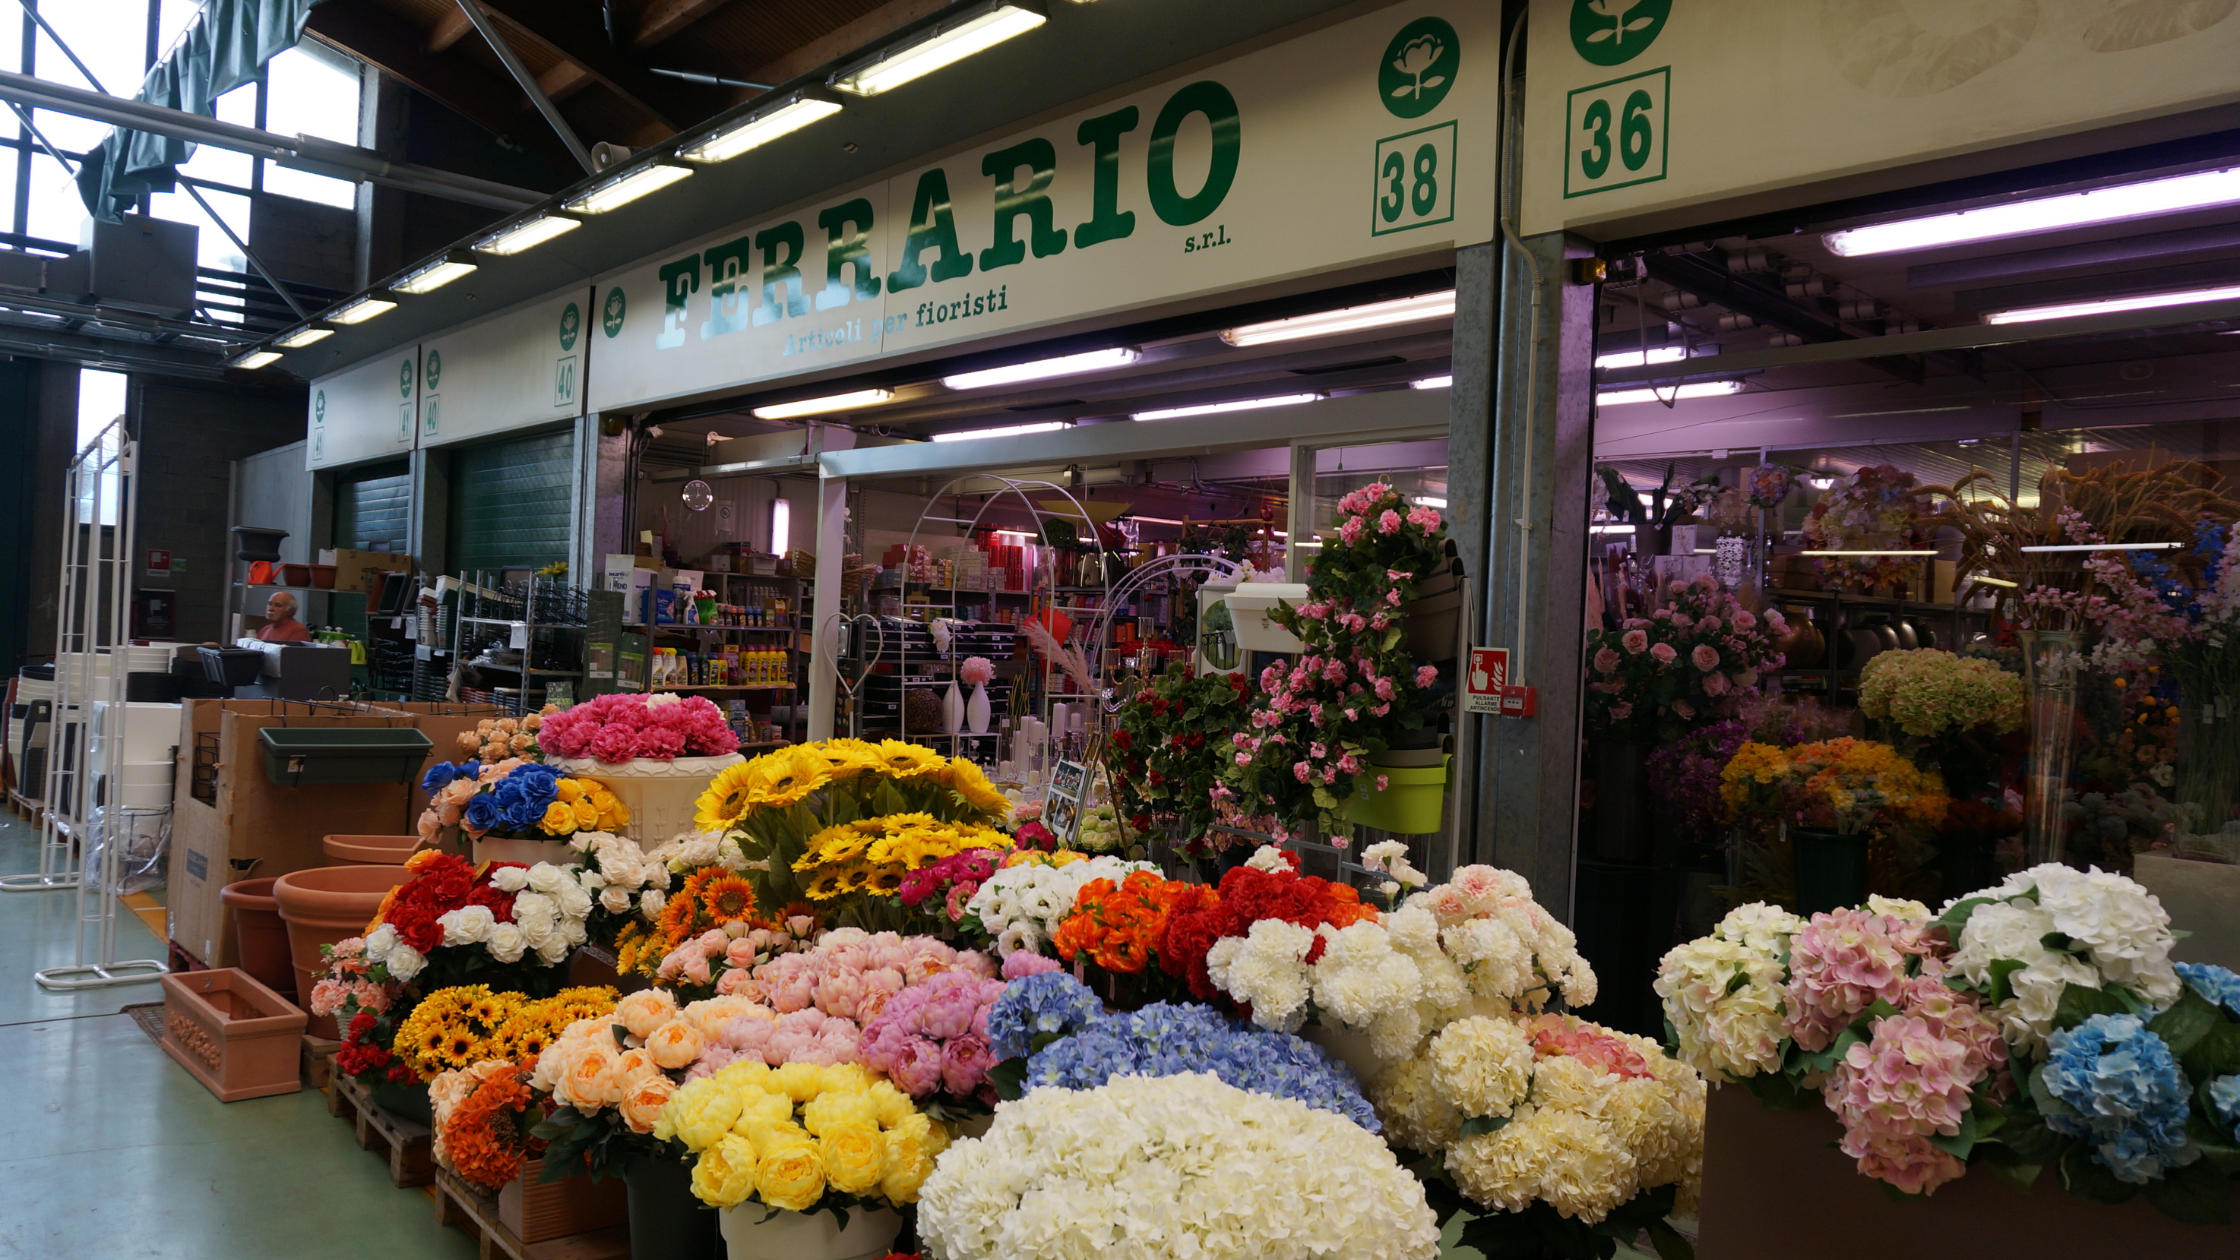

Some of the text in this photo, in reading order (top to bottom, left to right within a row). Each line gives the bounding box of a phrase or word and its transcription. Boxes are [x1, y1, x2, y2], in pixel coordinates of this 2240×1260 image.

[1581, 89, 1654, 180] 36
[656, 80, 1242, 351] FERRARIO
[1380, 143, 1438, 223] 38
[1184, 225, 1232, 254] s.r.l.
[782, 284, 1009, 357] Articoli per fioristi
[426, 400, 438, 430] 40
[557, 362, 573, 401] 40
